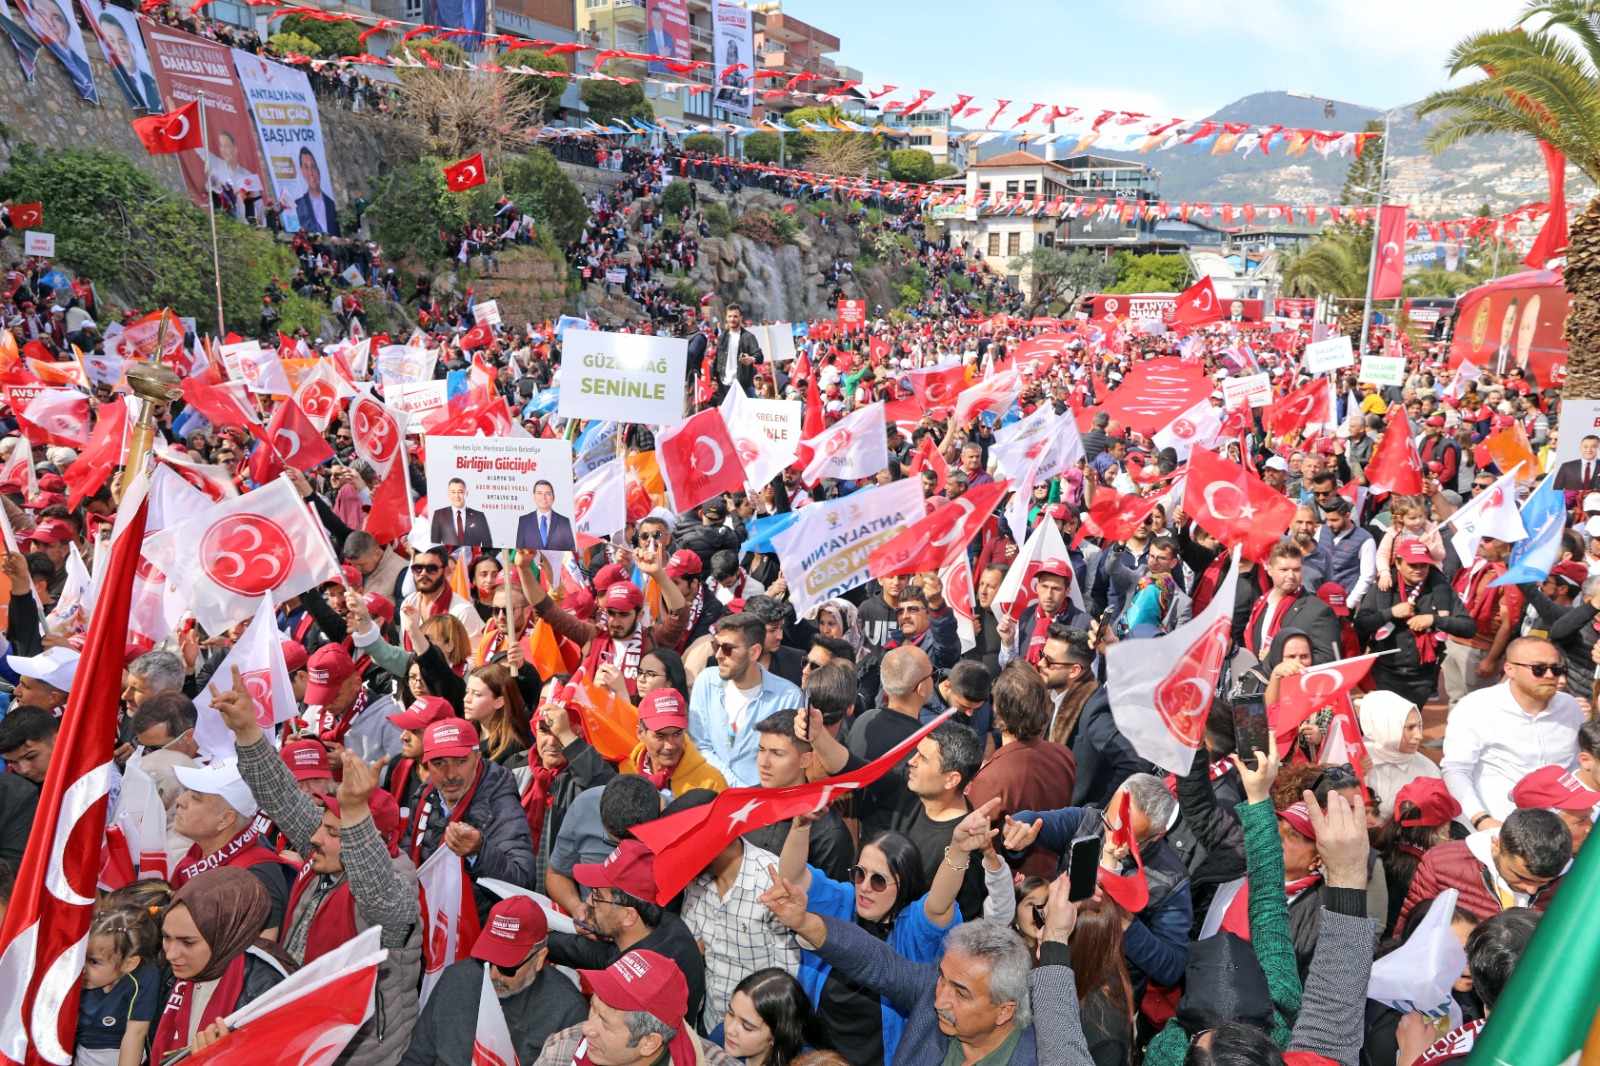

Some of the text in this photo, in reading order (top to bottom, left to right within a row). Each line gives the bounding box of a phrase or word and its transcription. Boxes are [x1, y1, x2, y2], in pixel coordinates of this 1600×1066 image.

[161, 55, 202, 73] DAHASI
[261, 128, 316, 147] BAŞLIYOR
[583, 352, 667, 374] GÜZAĞ
[581, 377, 666, 400] SENİNLE
[456, 456, 537, 473] Birliğin Gücüyle
[182, 849, 229, 879] YÜCEL
